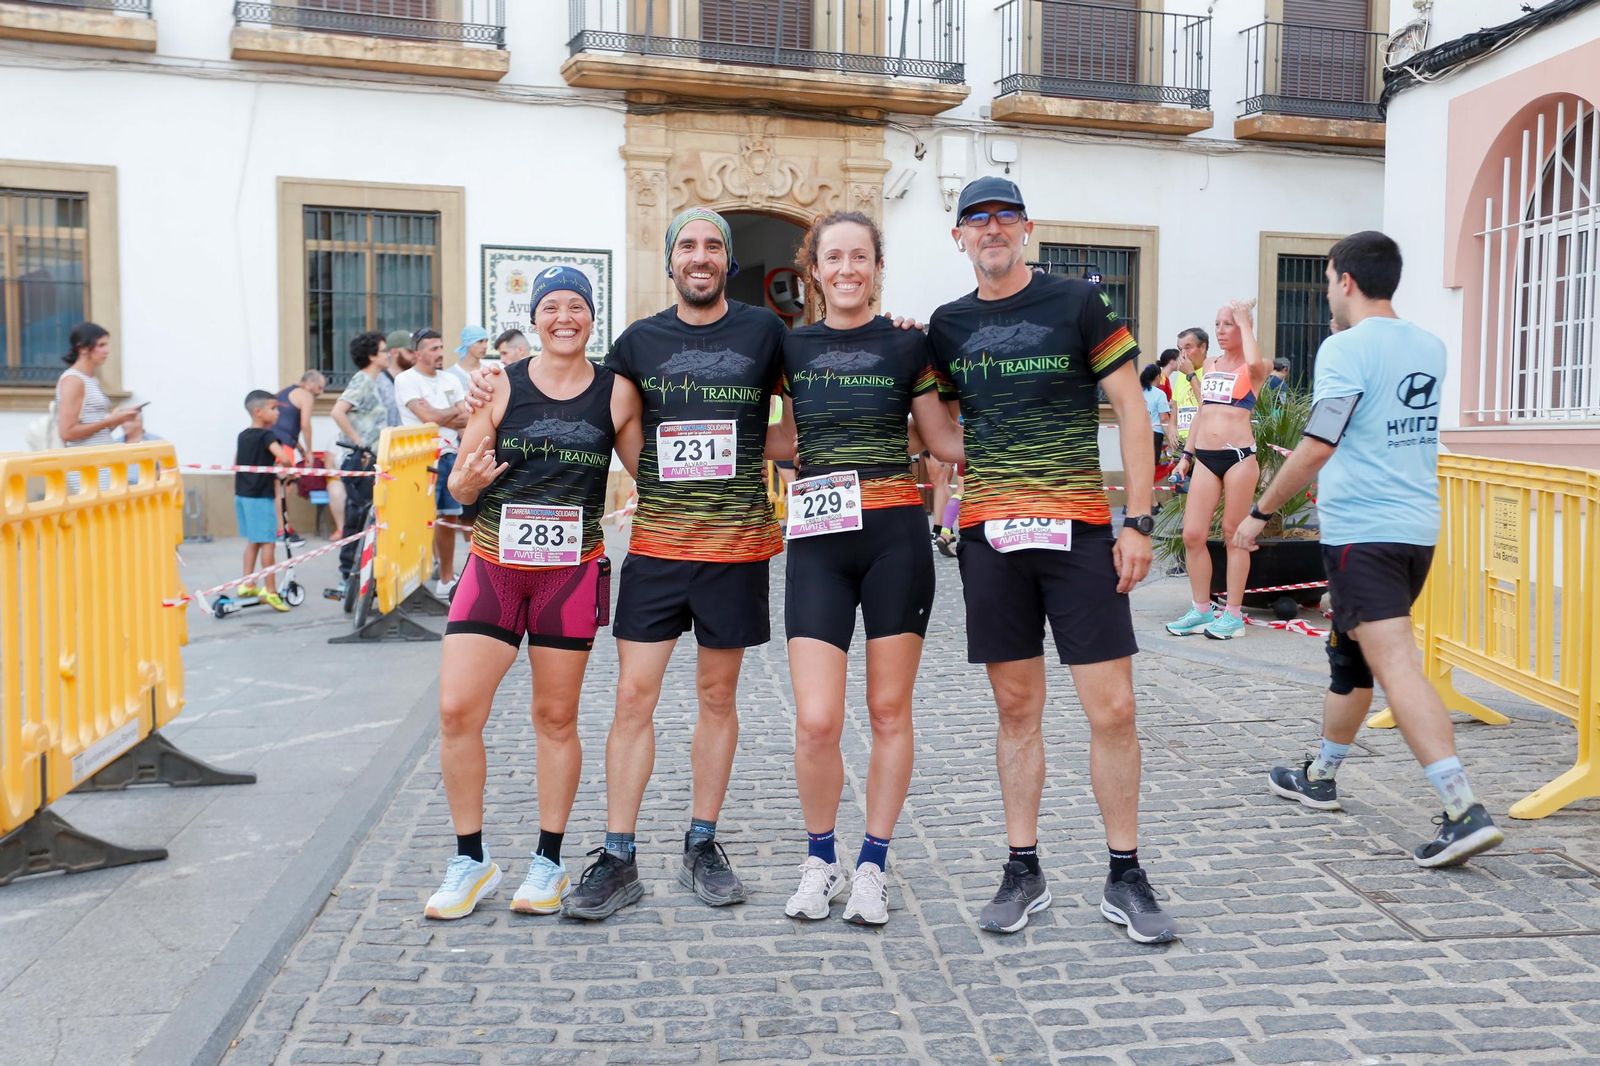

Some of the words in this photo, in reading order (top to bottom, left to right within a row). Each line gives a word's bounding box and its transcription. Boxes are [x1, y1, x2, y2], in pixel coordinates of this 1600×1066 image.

[999, 356, 1070, 374] TRAINING
[793, 370, 806, 380] MC
[840, 376, 895, 386] TRAINING
[1204, 380, 1224, 392] 331
[640, 377, 657, 389] MC
[701, 387, 761, 401] TRAINING
[1180, 414, 1192, 422] 119
[502, 438, 518, 448] MC
[559, 450, 608, 466] TRAINING
[673, 438, 715, 462] 231
[804, 492, 842, 518] 229
[518, 524, 564, 546] 283
[514, 551, 544, 559] AVATEL
